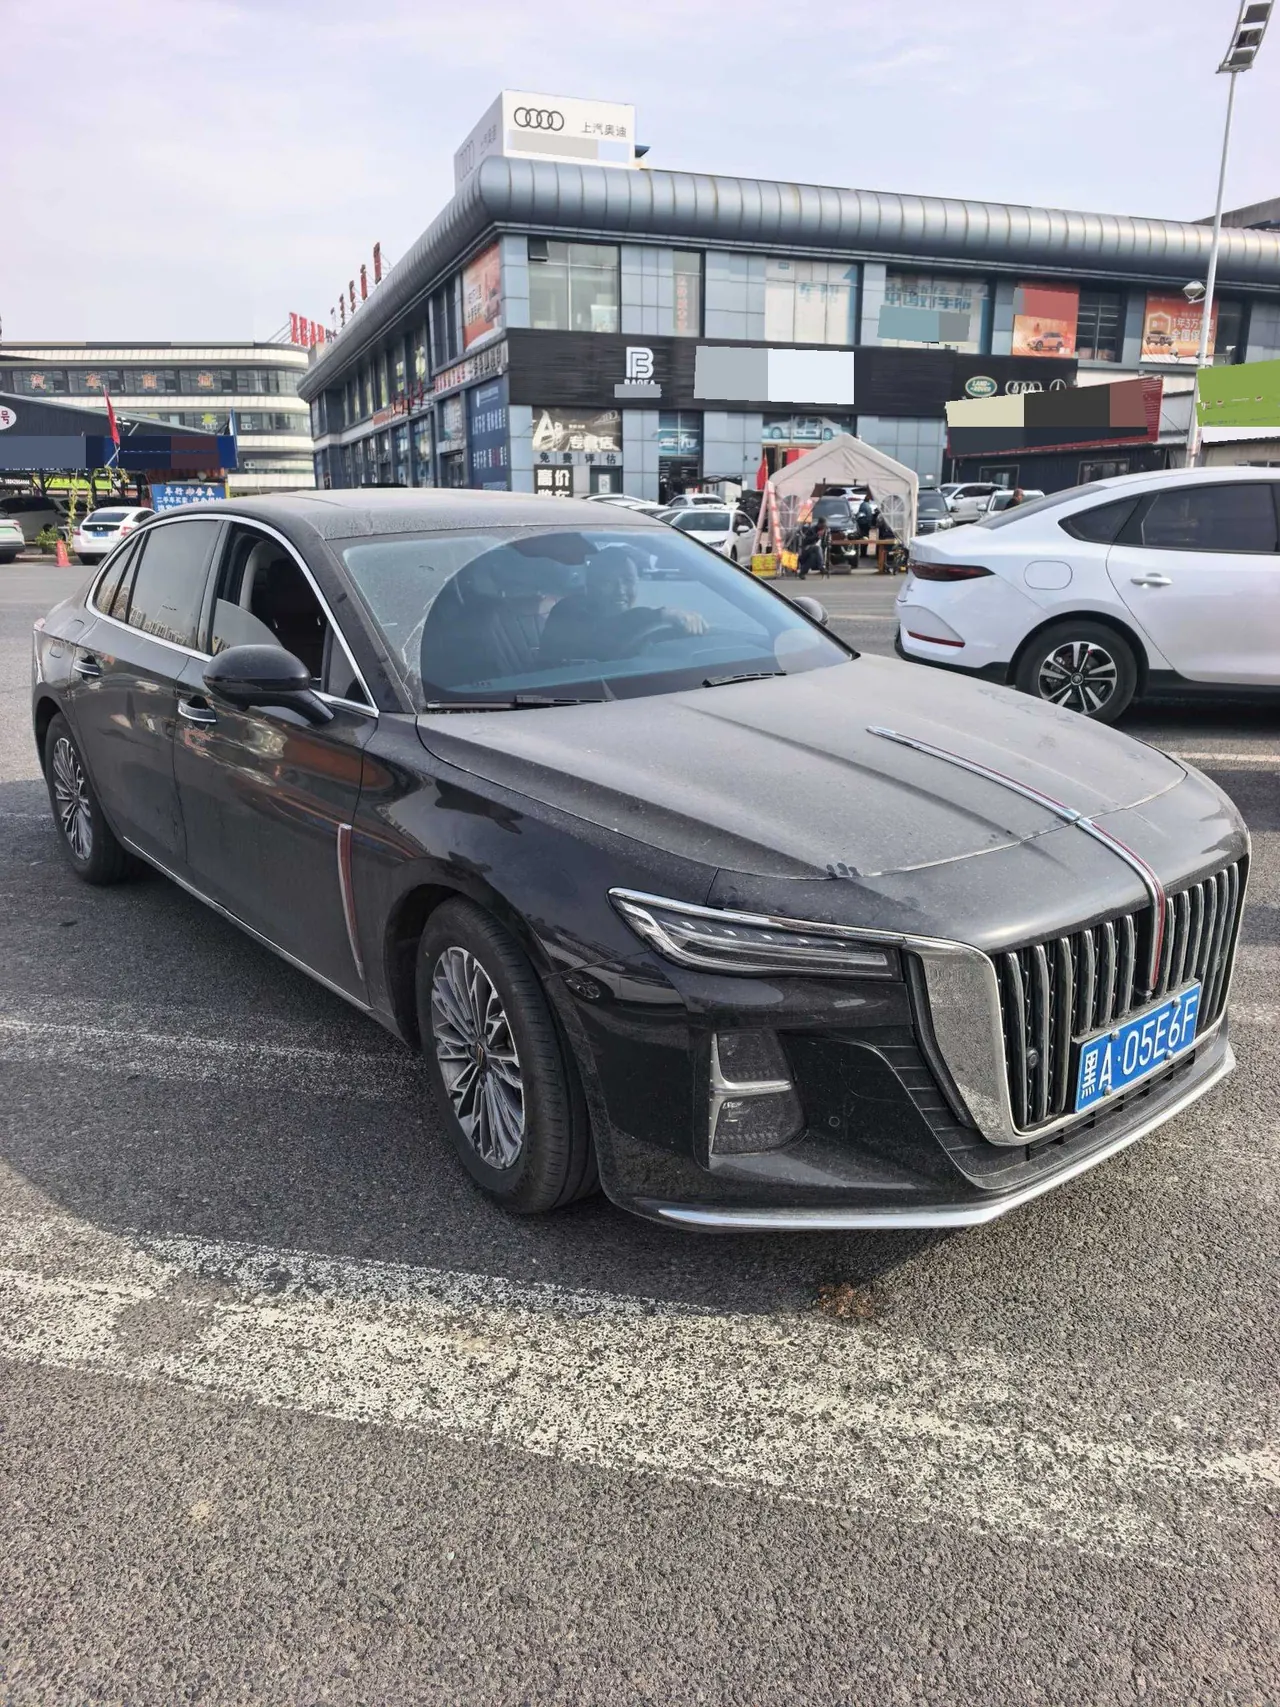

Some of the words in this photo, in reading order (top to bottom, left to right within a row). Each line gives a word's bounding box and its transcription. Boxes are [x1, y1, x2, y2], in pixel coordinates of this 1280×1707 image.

[581, 121, 627, 138] 上汽奥迪
[540, 451, 617, 465] 免费评估
[537, 469, 570, 487] 高价
